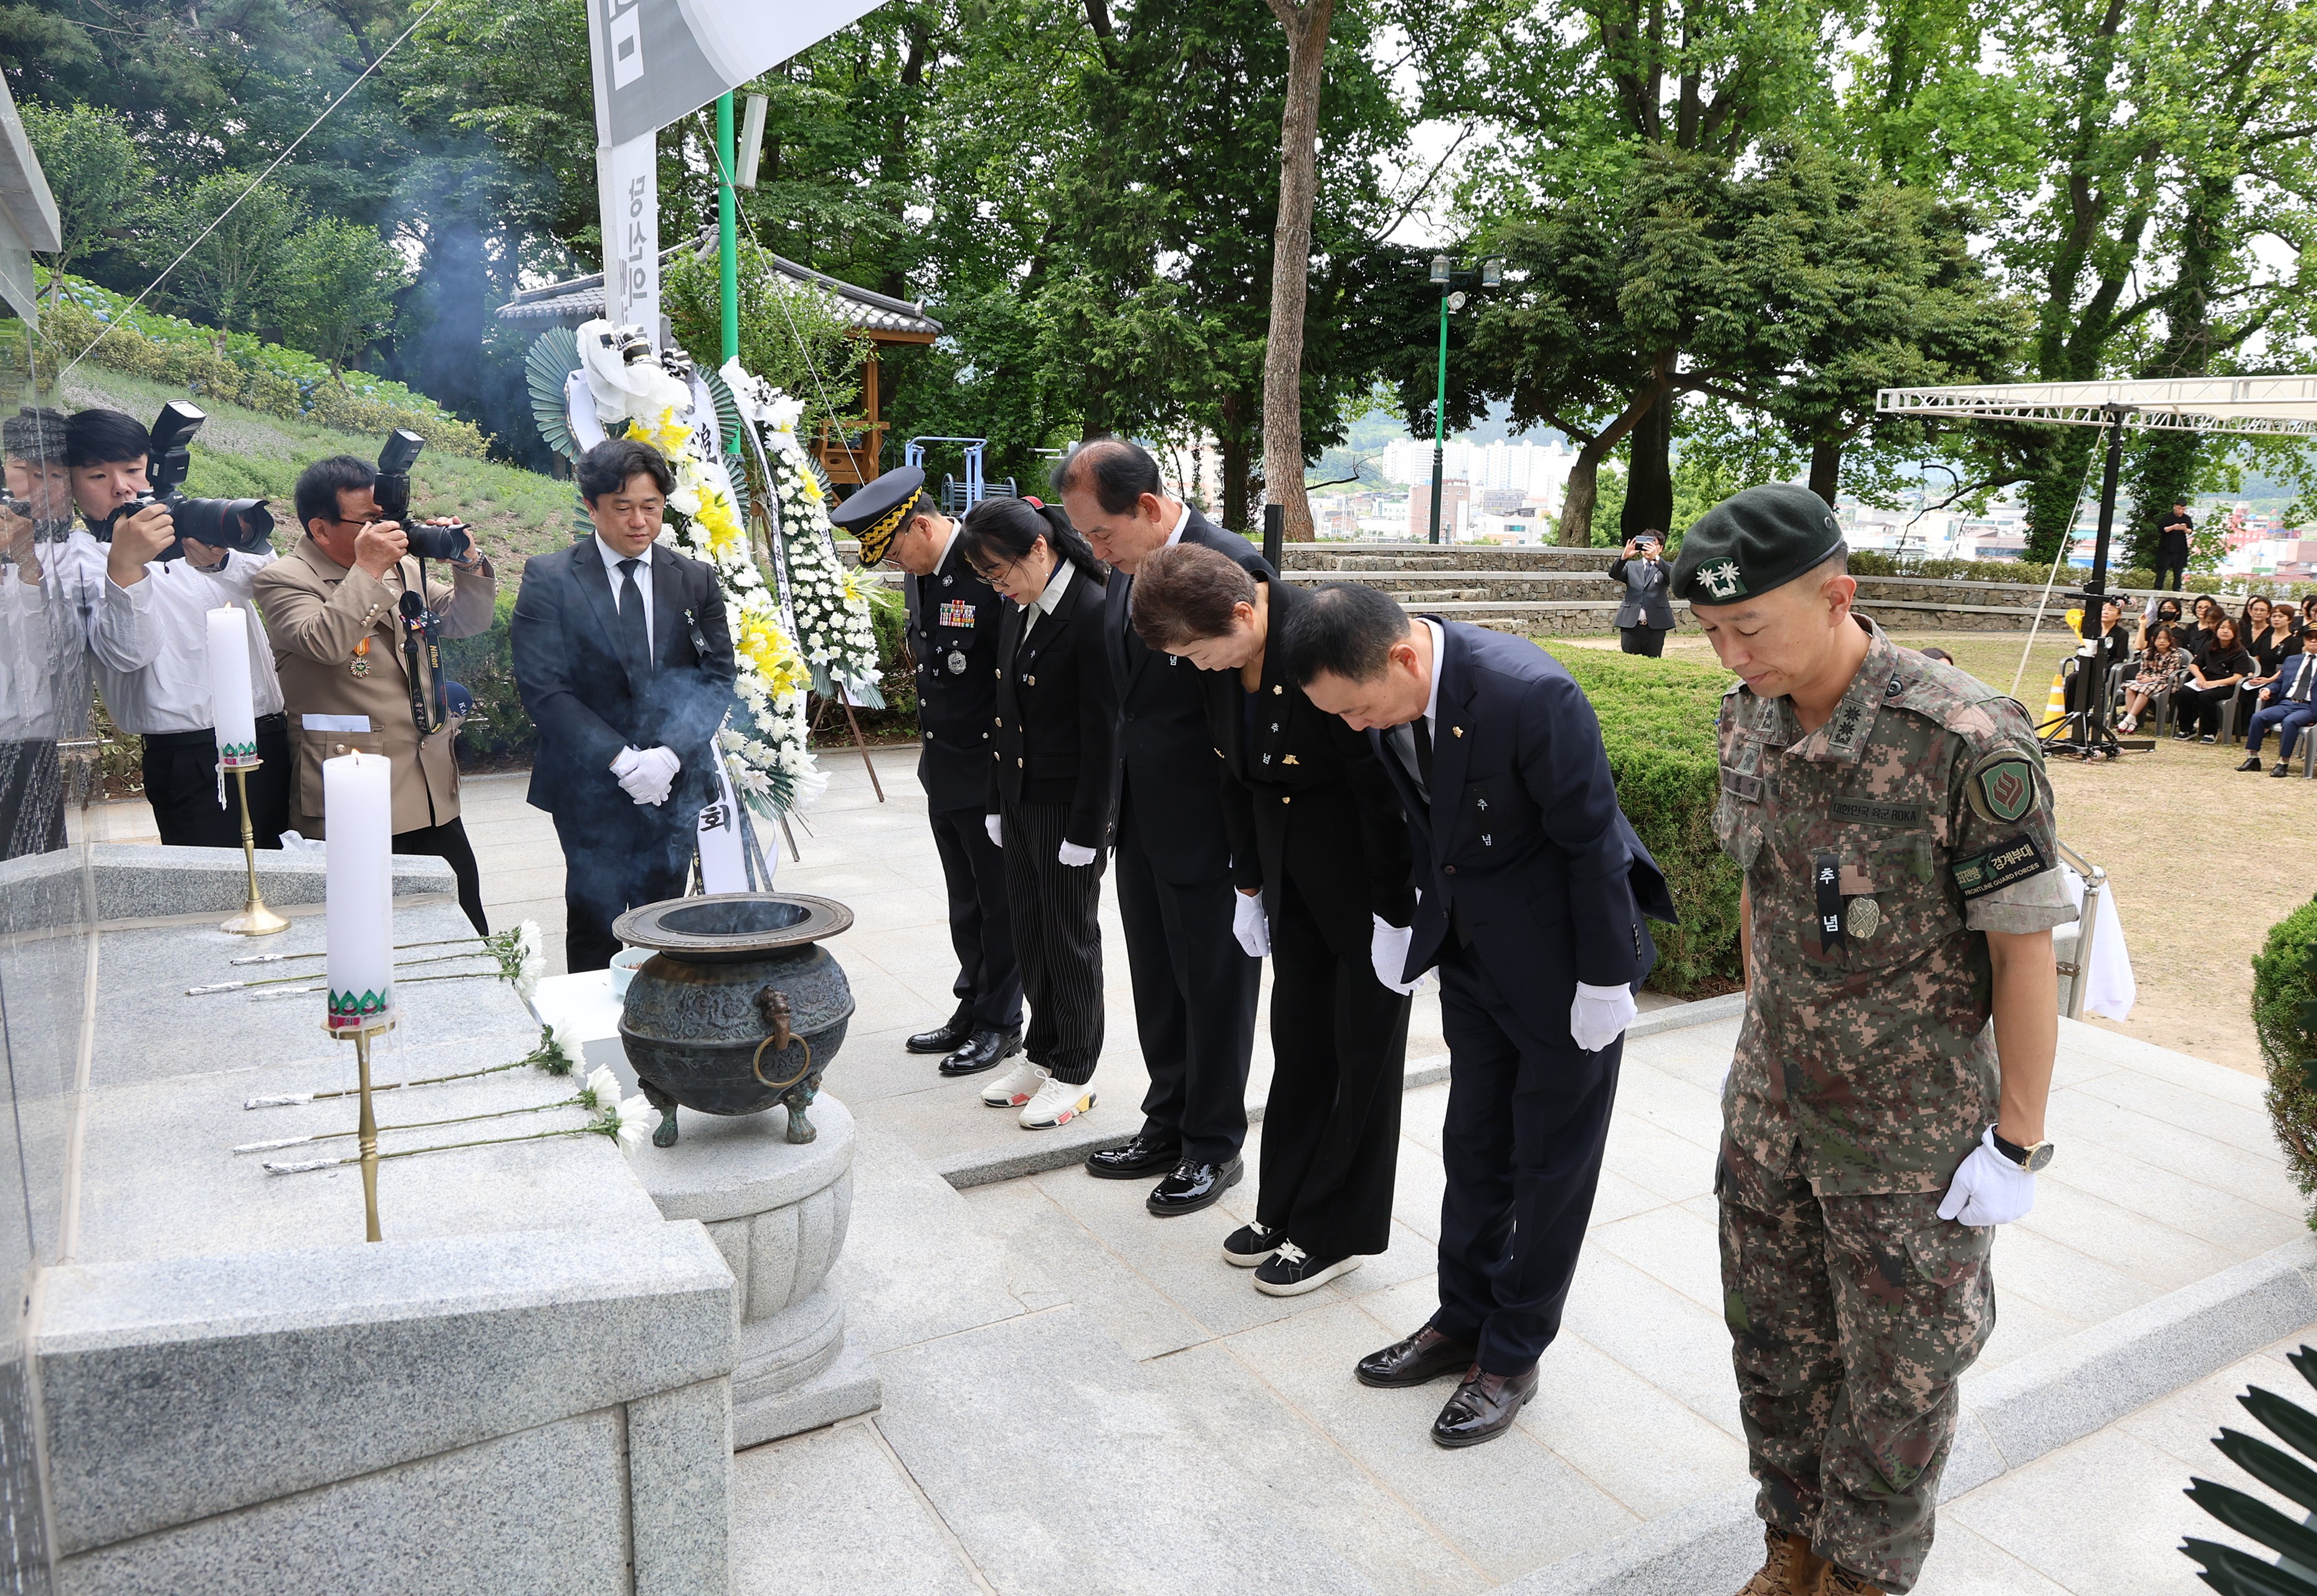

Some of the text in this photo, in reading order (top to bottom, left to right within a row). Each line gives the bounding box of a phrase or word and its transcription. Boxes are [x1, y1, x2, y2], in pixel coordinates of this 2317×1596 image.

[429, 645, 439, 668] Nikon
[1834, 803, 1916, 821] 대한민국 육군 ROKA
[1955, 843, 2034, 884] 최전방 경계부대
[1964, 862, 2040, 896] FRONTLINE GUARD FORCES
